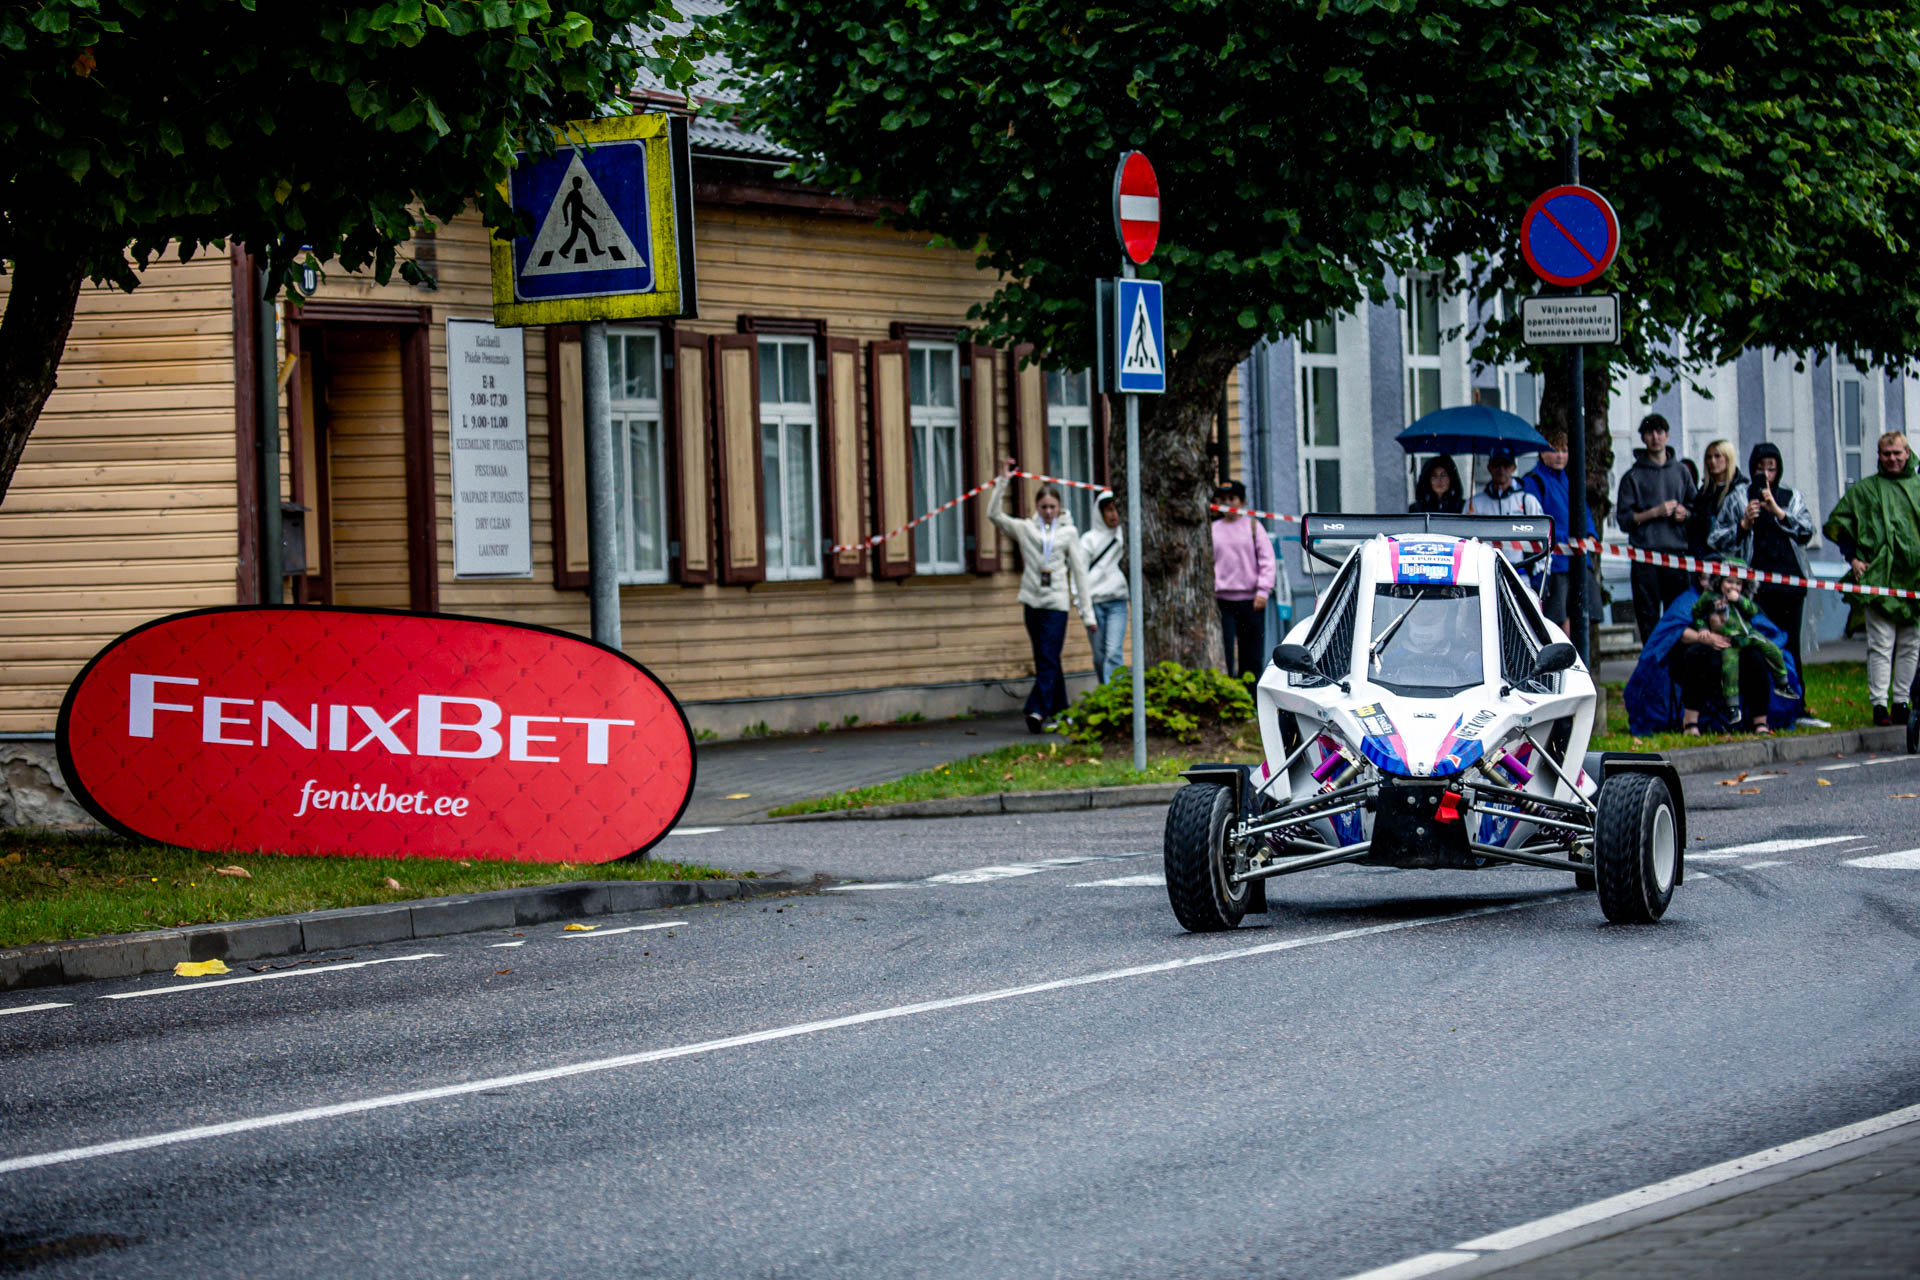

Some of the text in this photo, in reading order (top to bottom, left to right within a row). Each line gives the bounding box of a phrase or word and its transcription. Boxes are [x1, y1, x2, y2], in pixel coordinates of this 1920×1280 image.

[1541, 304, 1597, 315] Välja arvatud
[1529, 327, 1610, 338] teenindav sõidukid
[482, 375, 495, 389] E-R
[462, 414, 468, 428] L
[456, 438, 525, 451] KEEMILINE PUHASTUS
[460, 490, 525, 504] VAIPADE PUHASTUS
[475, 517, 511, 530] DRY CLEAN
[478, 544, 509, 557] LAUNDRY
[293, 779, 469, 818] fenixbet.ee
